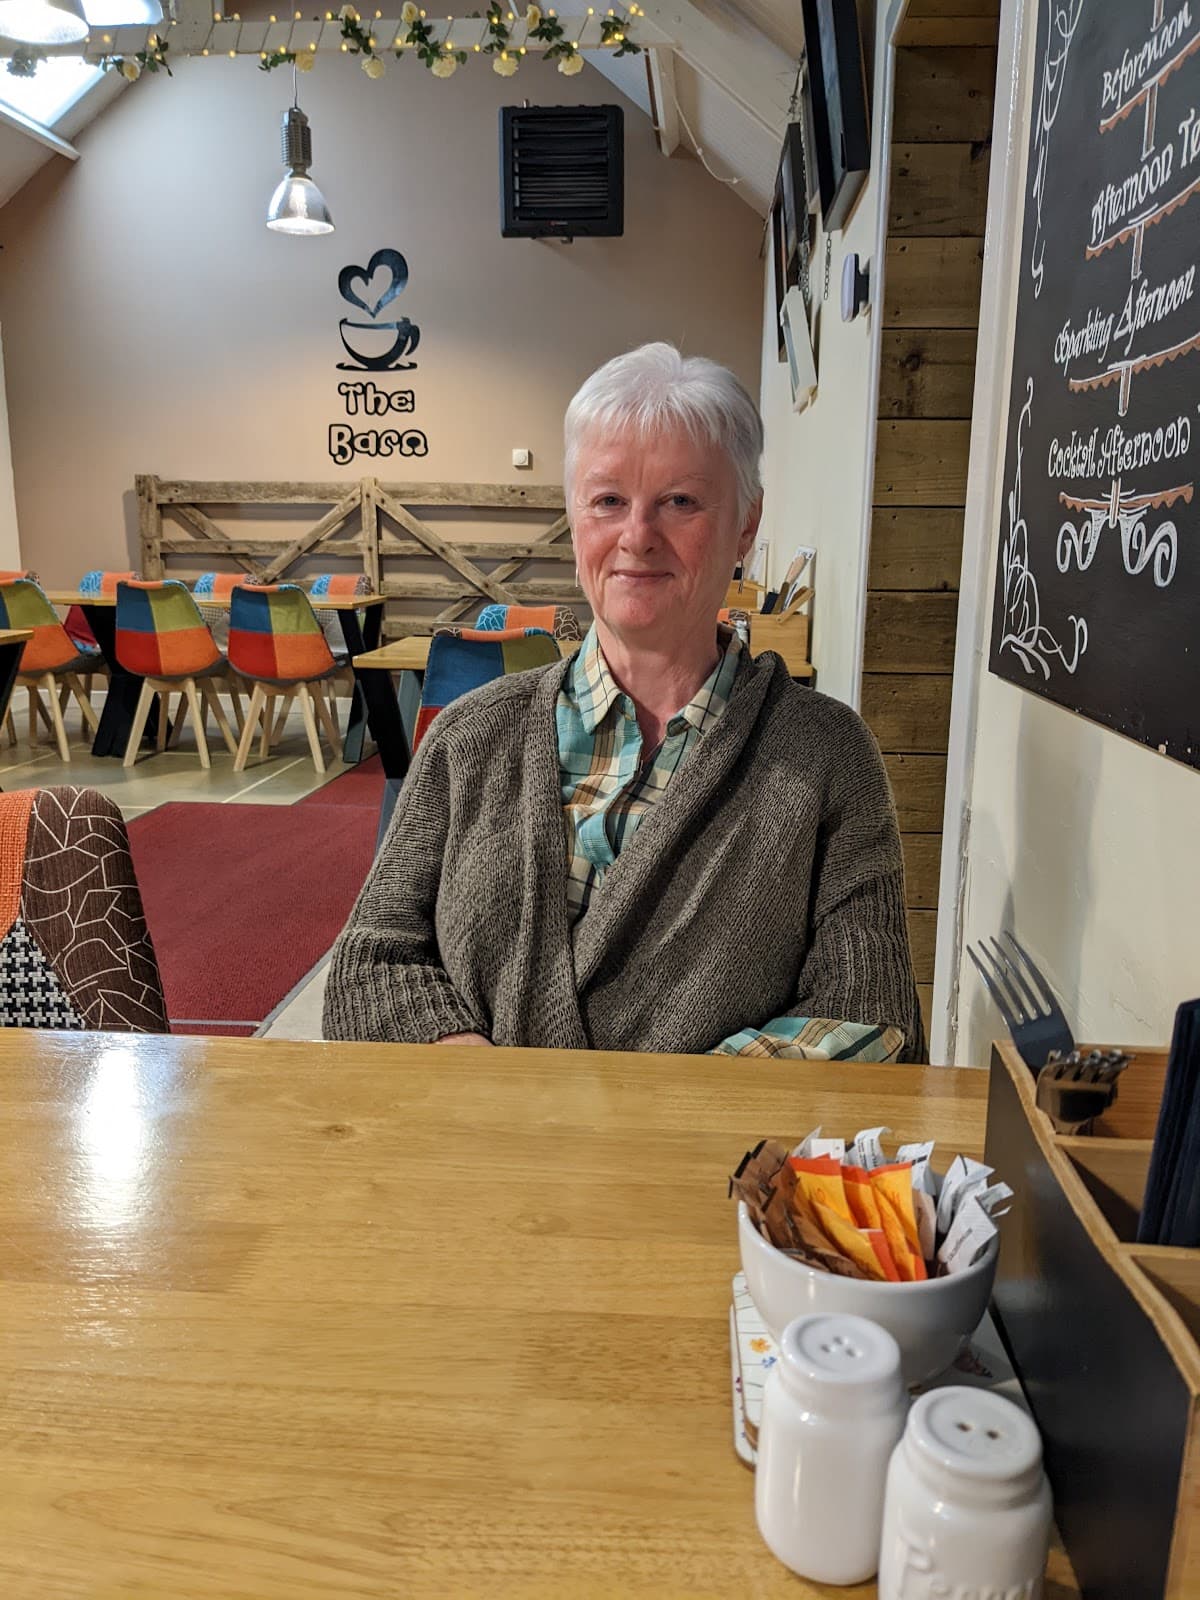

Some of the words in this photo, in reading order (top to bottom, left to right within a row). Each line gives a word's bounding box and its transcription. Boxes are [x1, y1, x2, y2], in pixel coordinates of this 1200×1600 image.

[1102, 1, 1192, 109] Beforenoon
[1091, 144, 1174, 243] Afternoon
[1054, 308, 1115, 375] Sparkling
[1113, 265, 1196, 356] Afternoon
[338, 381, 415, 416] The
[329, 423, 428, 465] Barn
[1048, 427, 1099, 478] Cocktail
[1098, 416, 1191, 477] Afternoon
